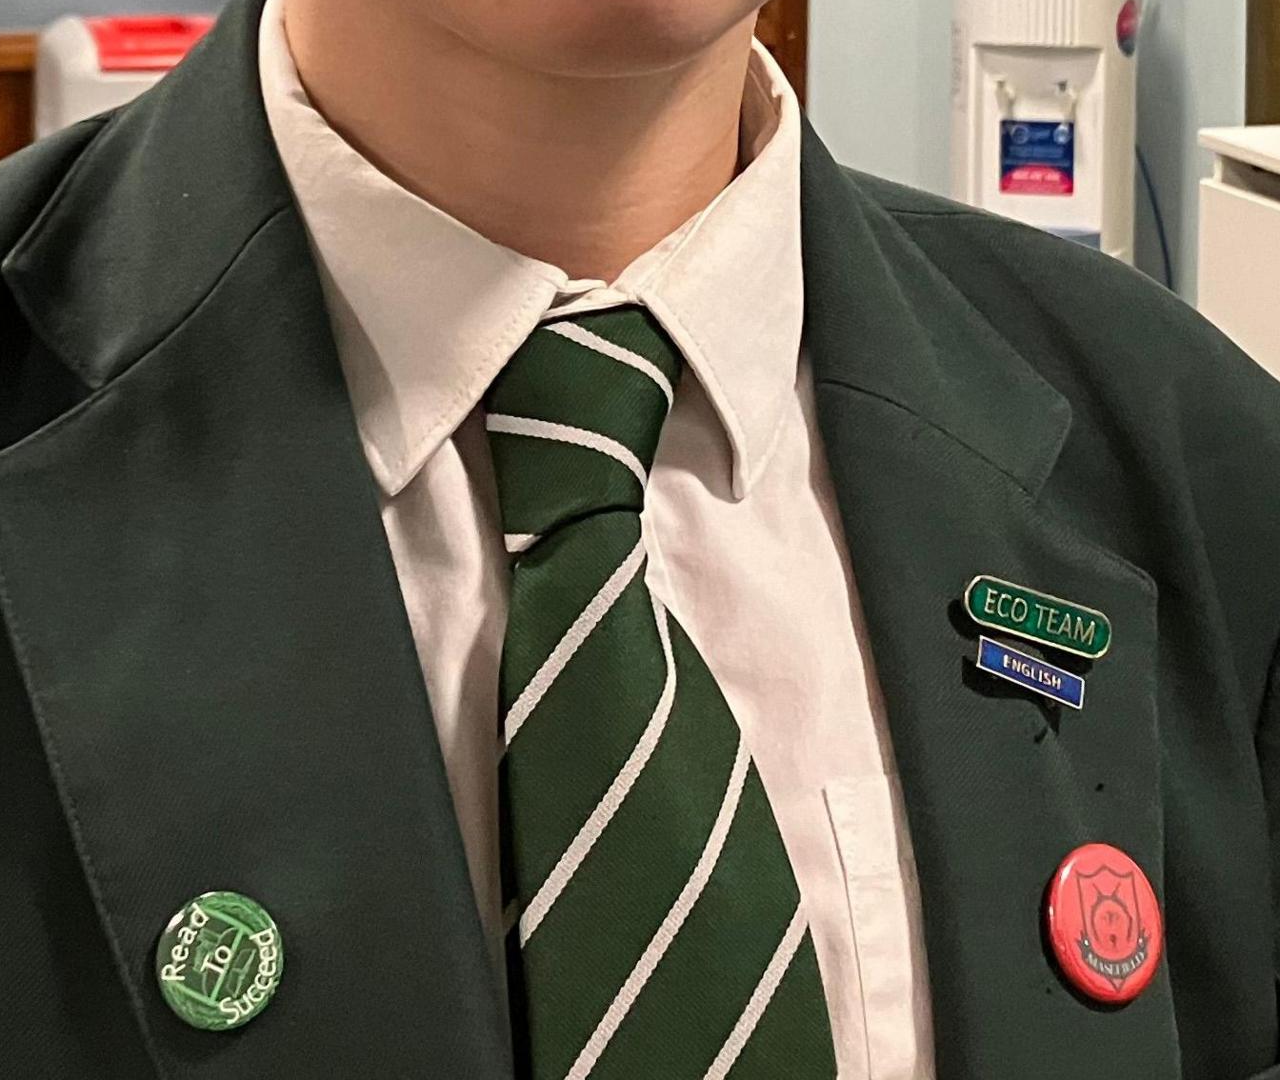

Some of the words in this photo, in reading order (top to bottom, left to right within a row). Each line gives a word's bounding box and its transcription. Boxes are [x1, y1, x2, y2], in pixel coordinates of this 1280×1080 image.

[984, 587, 1029, 623] ECO
[1034, 603, 1096, 646] TEAM
[1002, 654, 1062, 691] ENGLISH
[161, 902, 210, 982] Read
[200, 945, 233, 975] To
[219, 927, 278, 1025] Succeed
